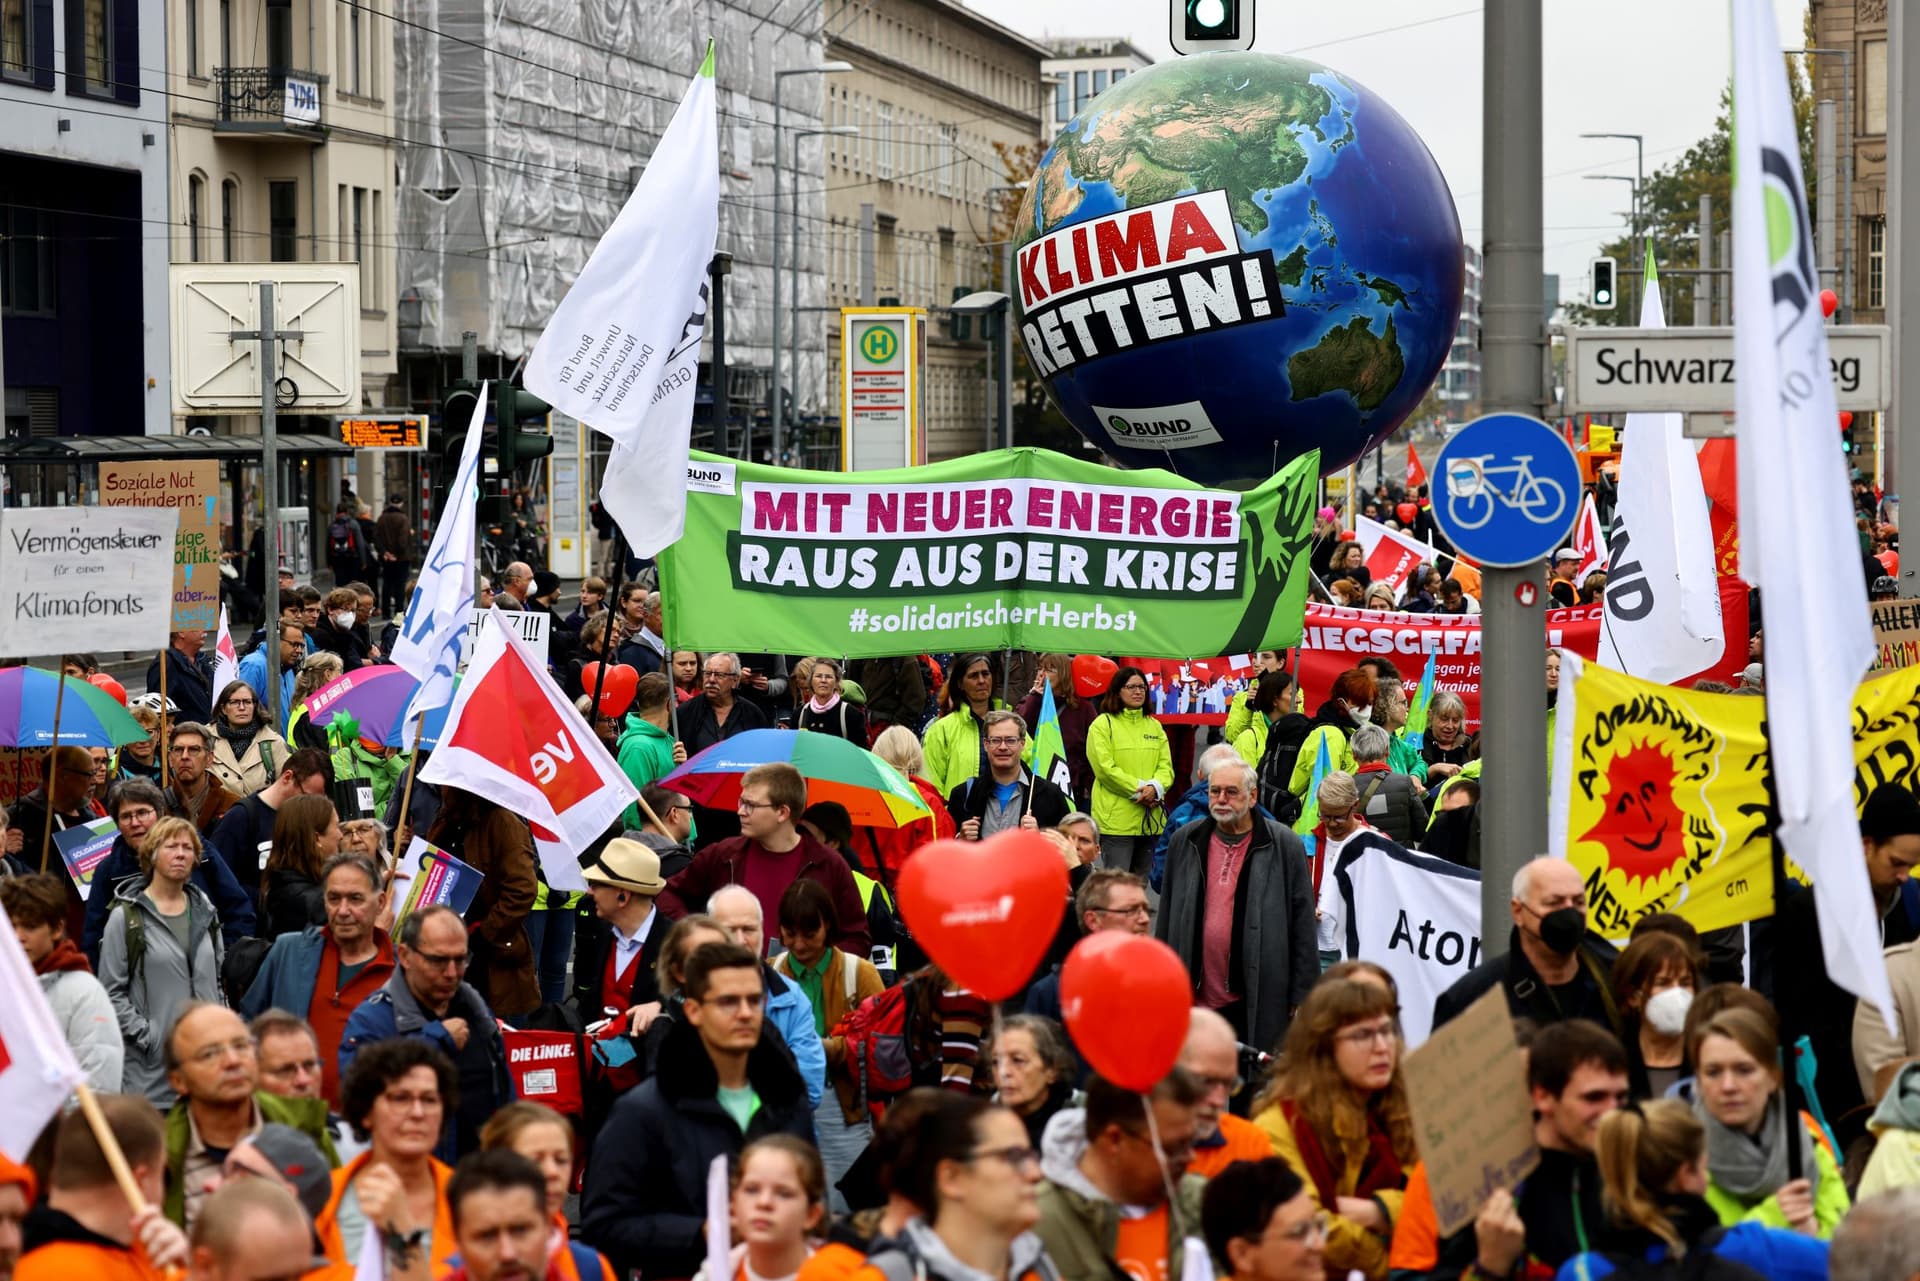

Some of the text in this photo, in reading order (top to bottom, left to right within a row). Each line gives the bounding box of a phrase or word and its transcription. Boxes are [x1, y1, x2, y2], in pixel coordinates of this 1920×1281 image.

[1020, 200, 1227, 308] KLIMA
[1022, 257, 1272, 378] RETTEN!
[870, 334, 888, 355] H
[1596, 347, 1735, 385] Schwarz
[1132, 418, 1192, 436] BUND
[105, 471, 195, 491] Soziale Not
[106, 491, 203, 507] verhindern:
[753, 486, 1233, 538] MIT NEUER ENERGIE
[11, 526, 162, 554] Vermögensteuer
[174, 529, 206, 547] tige
[173, 545, 217, 565] olitik:
[739, 541, 1238, 592] RAUS AUS DER KRISE
[54, 564, 104, 576] für einen
[1606, 514, 1655, 622] ND
[15, 590, 144, 620] Klimafonds
[848, 599, 1137, 633] #solidarischerHerbst
[1466, 662, 1482, 678] je
[510, 1047, 532, 1063] DIE
